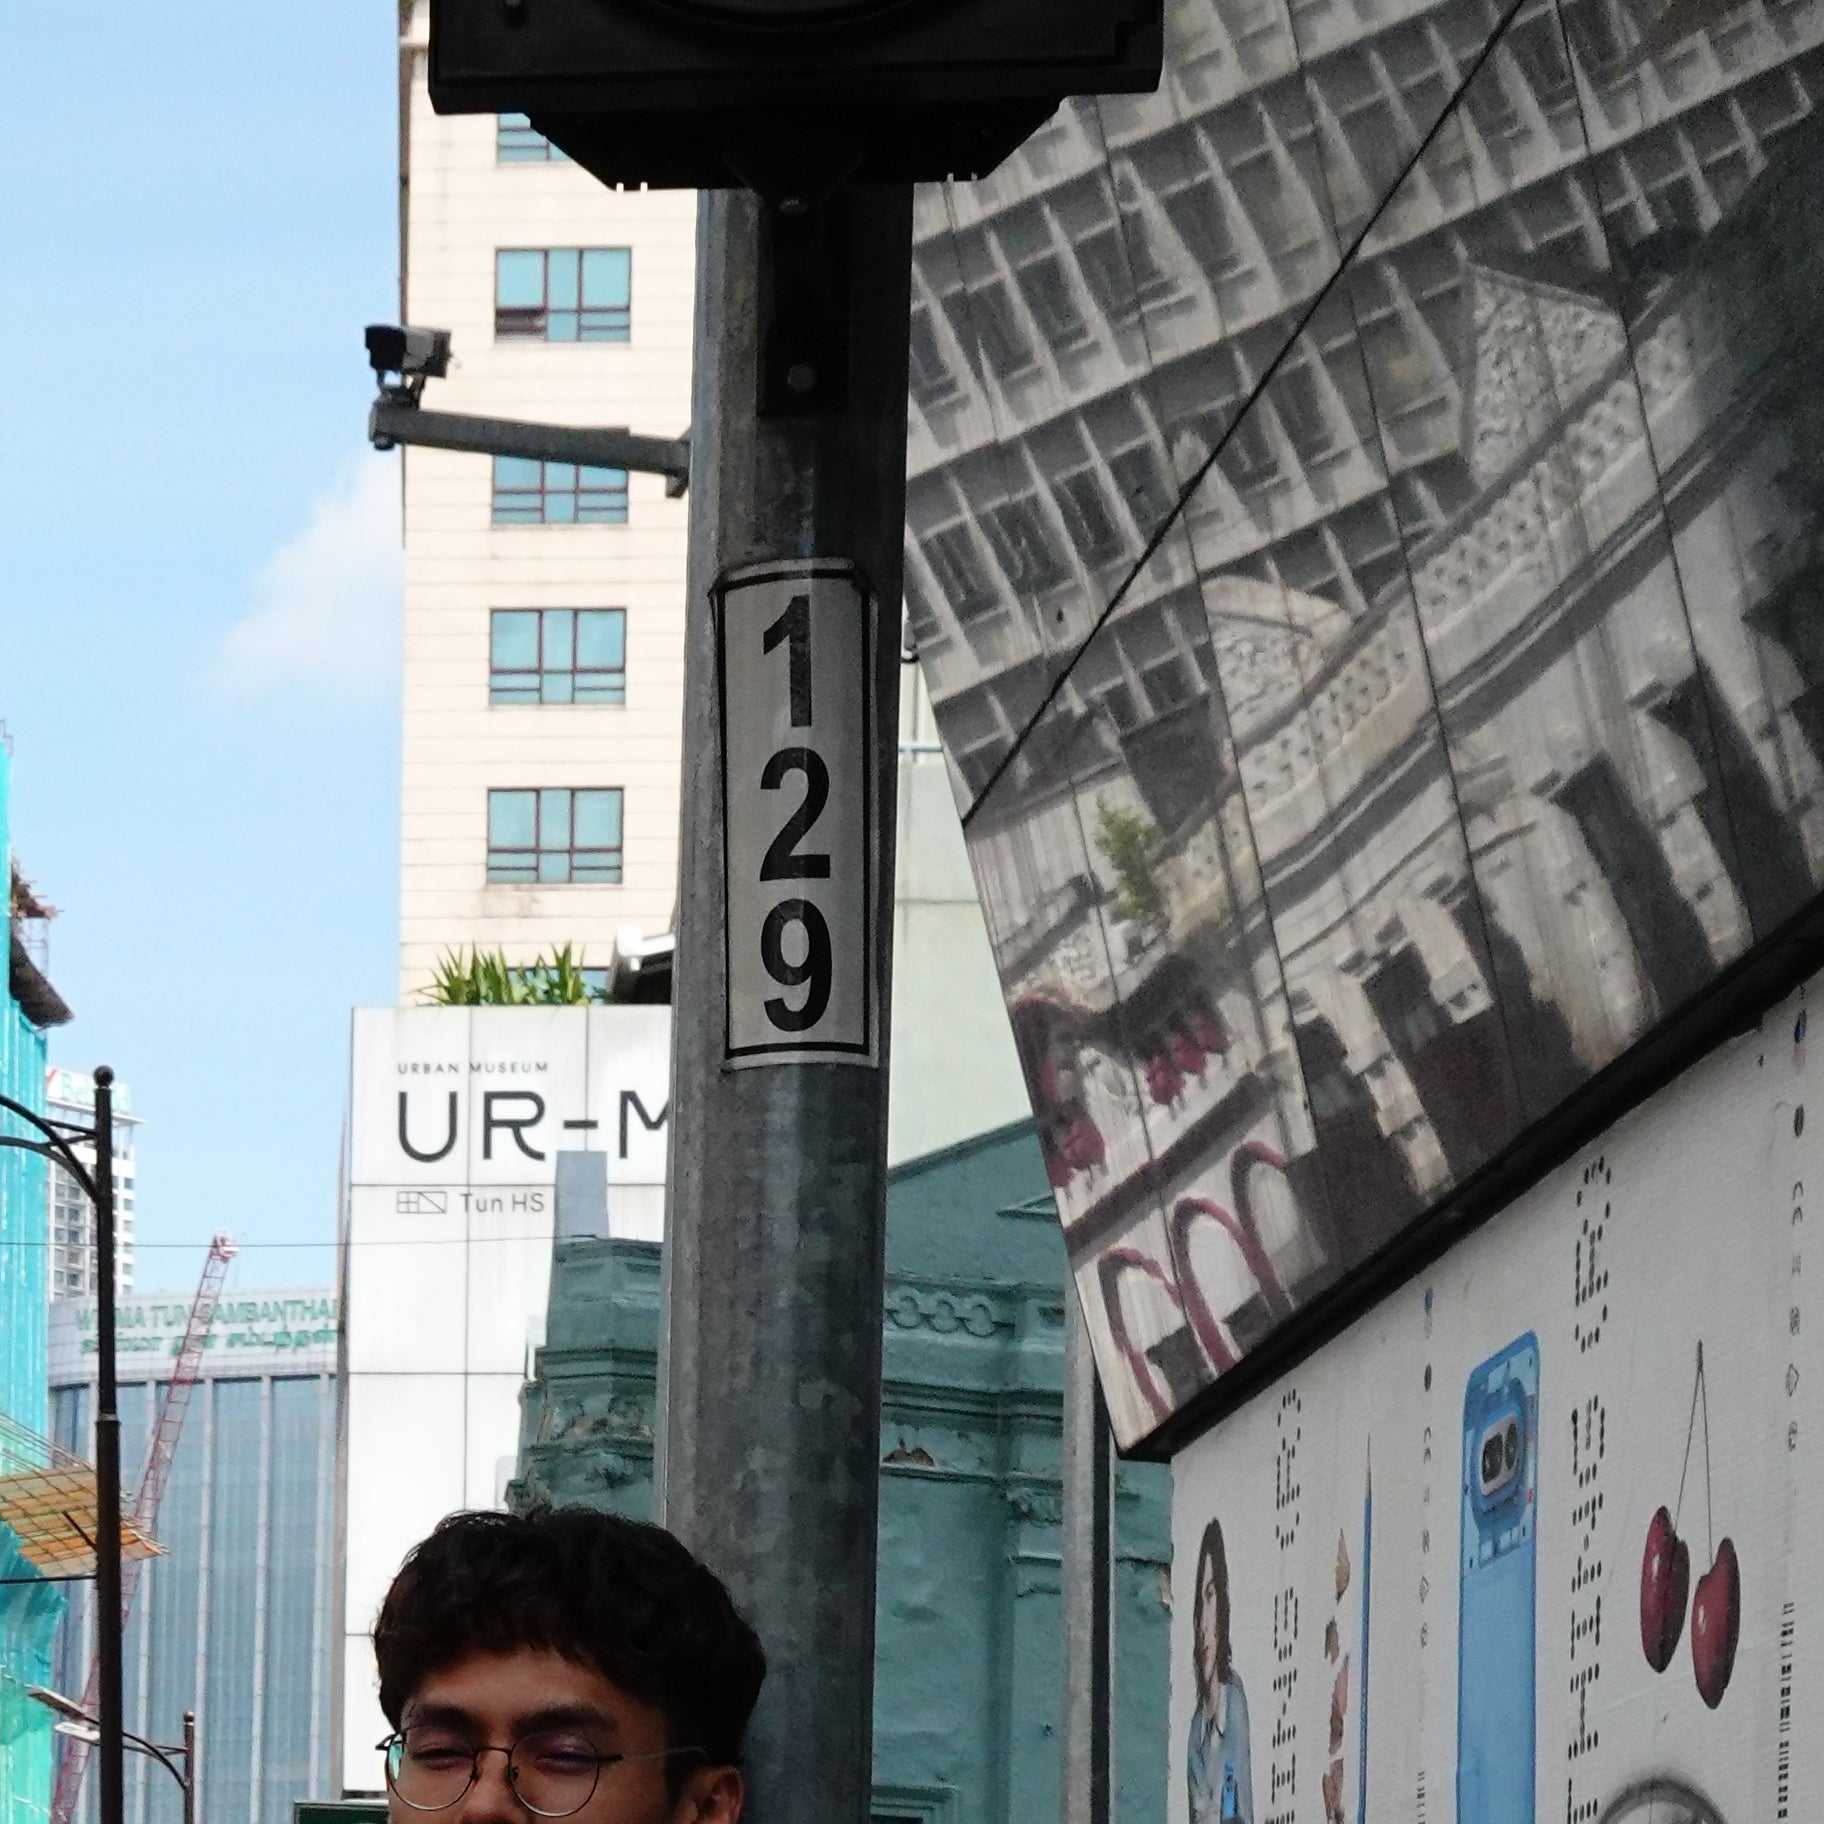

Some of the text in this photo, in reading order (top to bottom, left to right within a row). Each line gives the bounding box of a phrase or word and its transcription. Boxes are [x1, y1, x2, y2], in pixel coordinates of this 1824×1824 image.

[760, 594, 832, 1033] 129
[397, 1062, 549, 1075] URBAN MUSEUM
[462, 1192, 545, 1213] Tun HS
